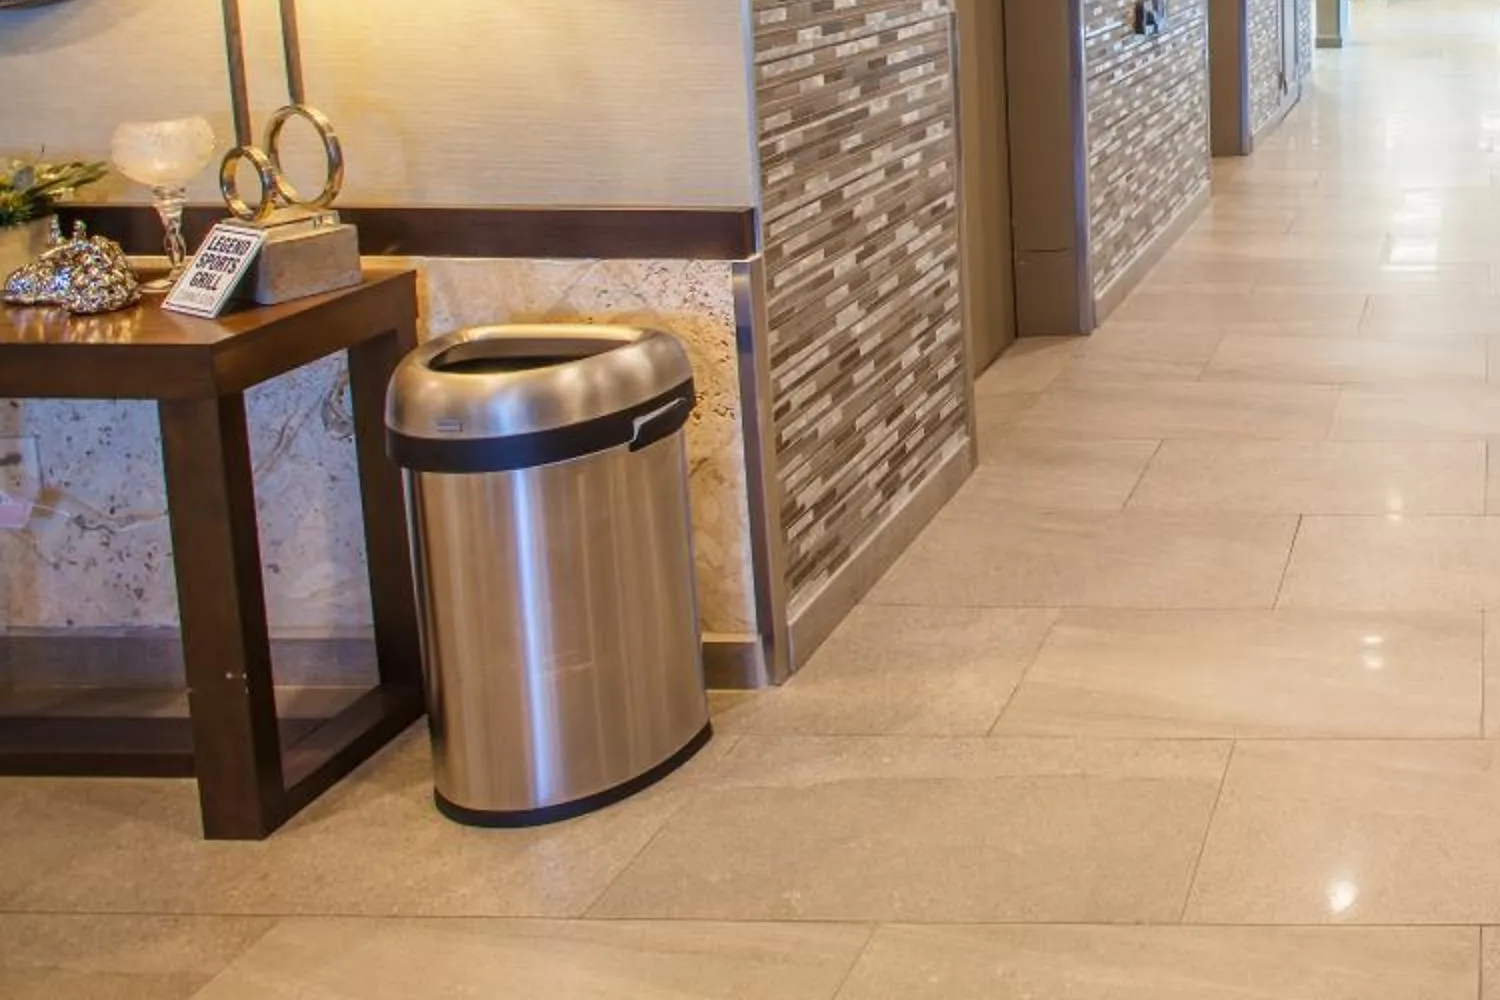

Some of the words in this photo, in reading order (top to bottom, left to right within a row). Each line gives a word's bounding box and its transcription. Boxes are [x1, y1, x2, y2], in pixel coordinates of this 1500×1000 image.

[207, 235, 251, 256] LEGEND
[195, 252, 241, 274] SPORTS
[189, 270, 223, 290] GRILL
